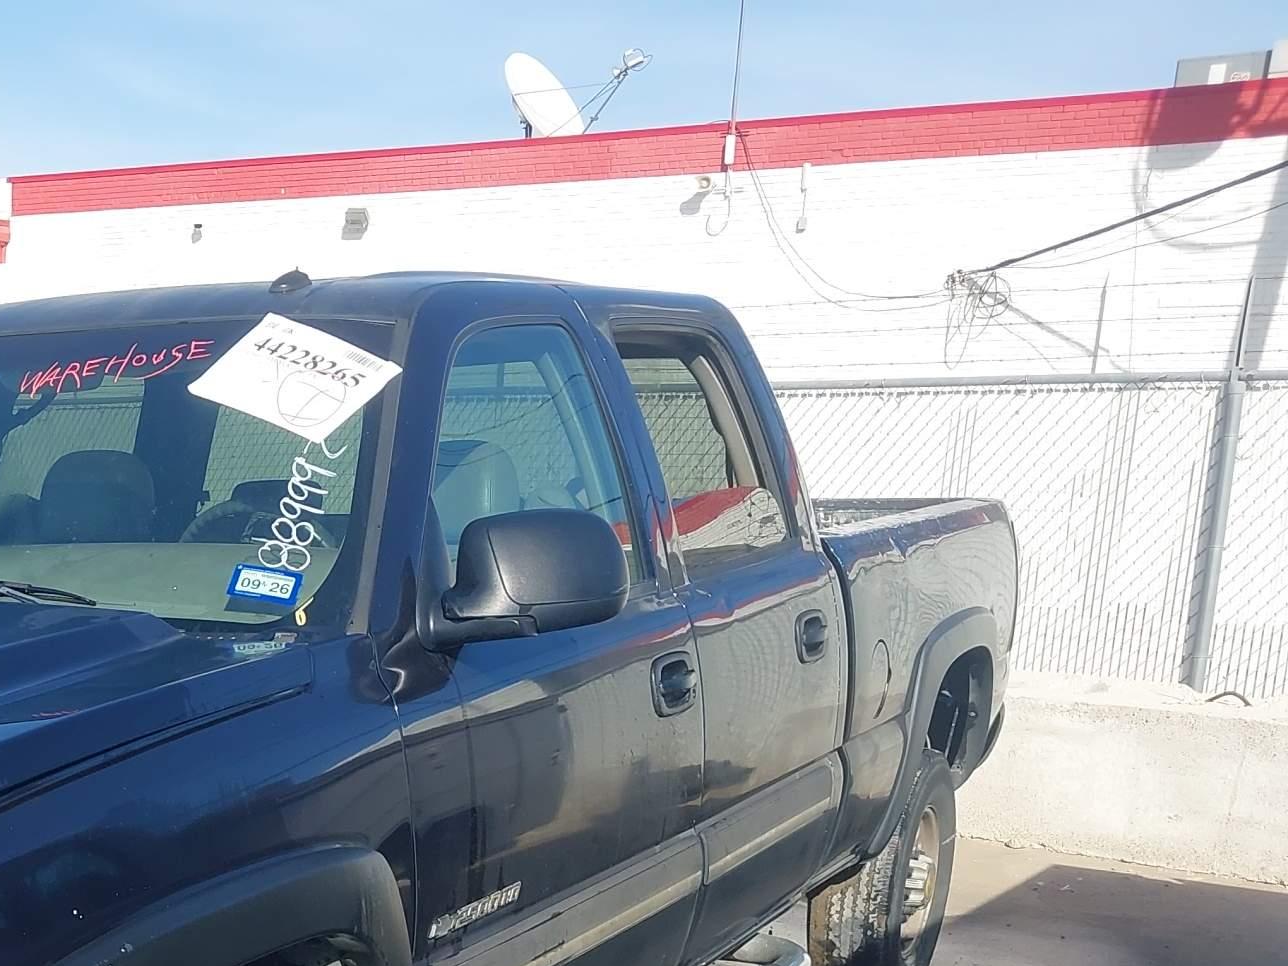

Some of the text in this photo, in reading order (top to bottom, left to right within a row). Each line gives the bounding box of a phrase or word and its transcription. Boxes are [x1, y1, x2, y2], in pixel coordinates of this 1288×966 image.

[21, 340, 215, 398] WAREHOUSE
[254, 337, 366, 388] 44228265
[240, 577, 262, 590] 09
[269, 582, 291, 595] 26
